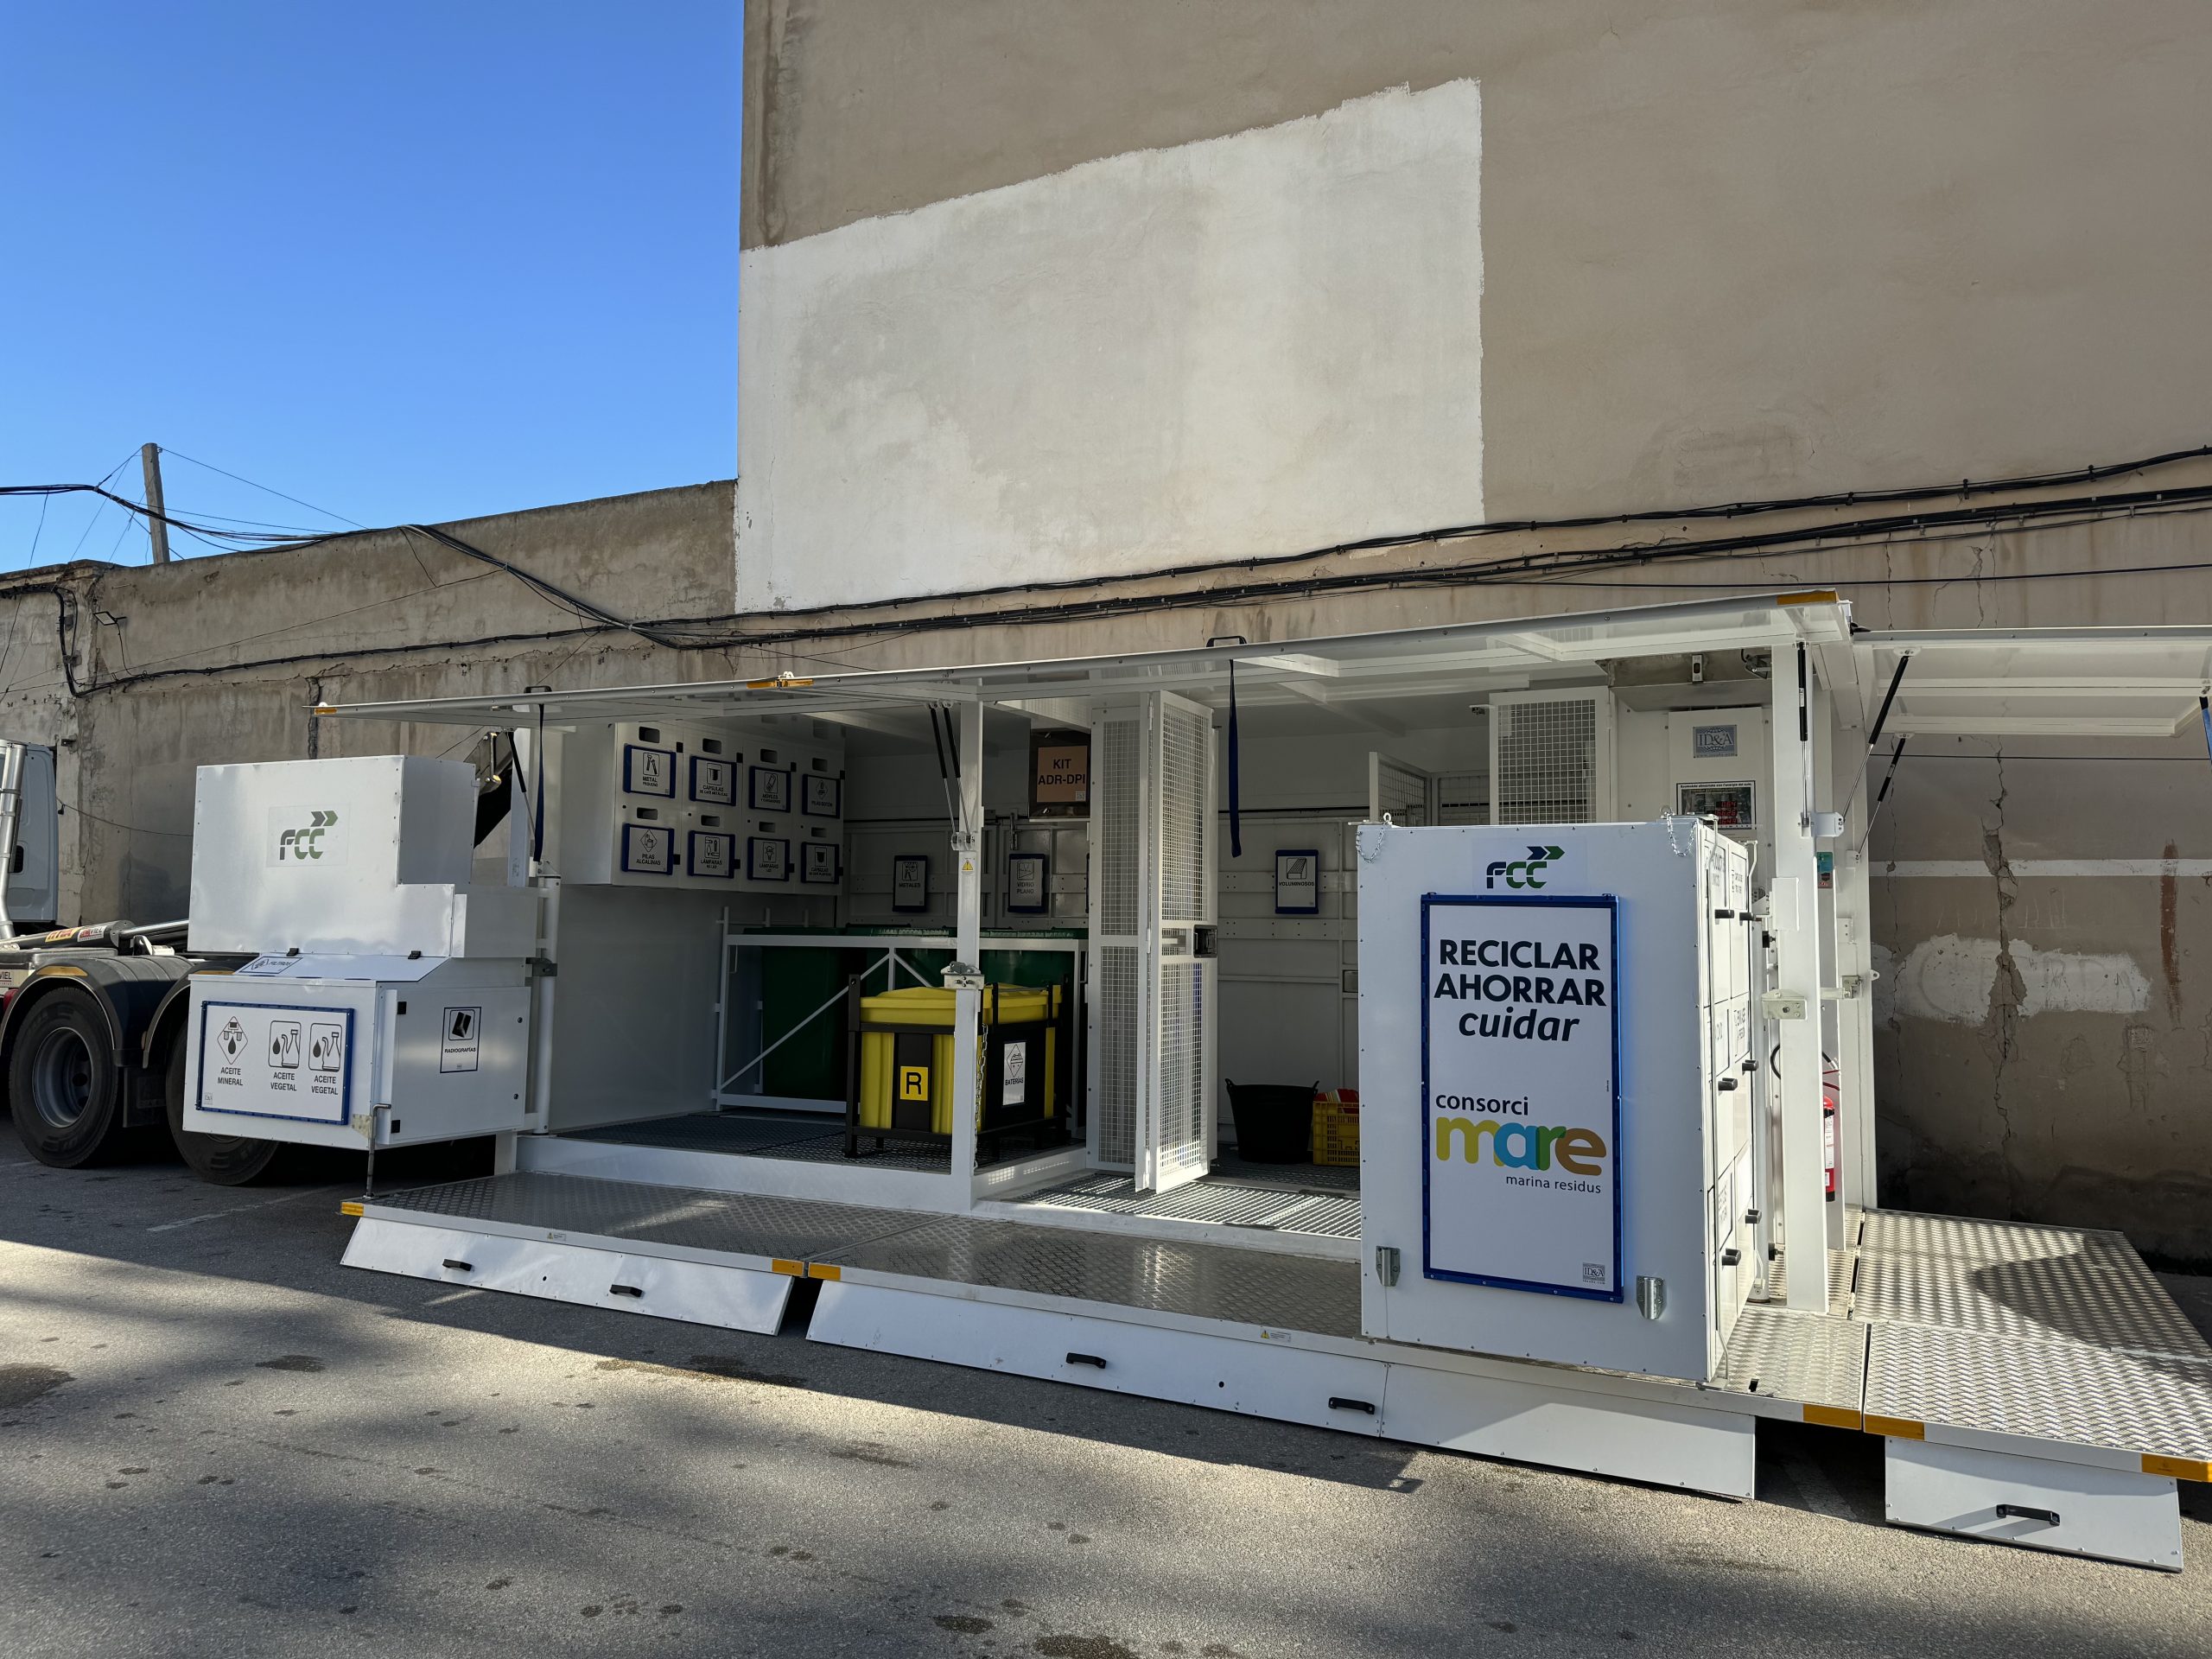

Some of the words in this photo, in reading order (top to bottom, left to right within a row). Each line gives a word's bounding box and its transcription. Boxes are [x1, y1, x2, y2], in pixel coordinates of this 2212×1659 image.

[1696, 733, 1733, 747] ID&A
[1052, 759, 1071, 769] KIT
[1038, 773, 1085, 785] ADR-DPI
[279, 828, 326, 861] FCC
[1486, 861, 1548, 889] FCC
[1440, 938, 1602, 971] RECICLAR
[1433, 973, 1607, 1007] AHORRAR
[1459, 1006, 1580, 1042] cuidar
[220, 1066, 242, 1076] ACEITE
[273, 1071, 296, 1081] ACEITE
[217, 1077, 244, 1086] MINERAL
[270, 1082, 297, 1091] VEGETAL
[314, 1075, 337, 1084] ACEITE
[906, 1071, 922, 1095] R
[1004, 1077, 1024, 1086] BATERÍAS
[311, 1085, 339, 1096] VEGETAL
[1435, 1094, 1529, 1116] consorci
[1436, 1116, 1607, 1176] mare
[1506, 1176, 1550, 1189] marina
[1554, 1180, 1601, 1194] residus
